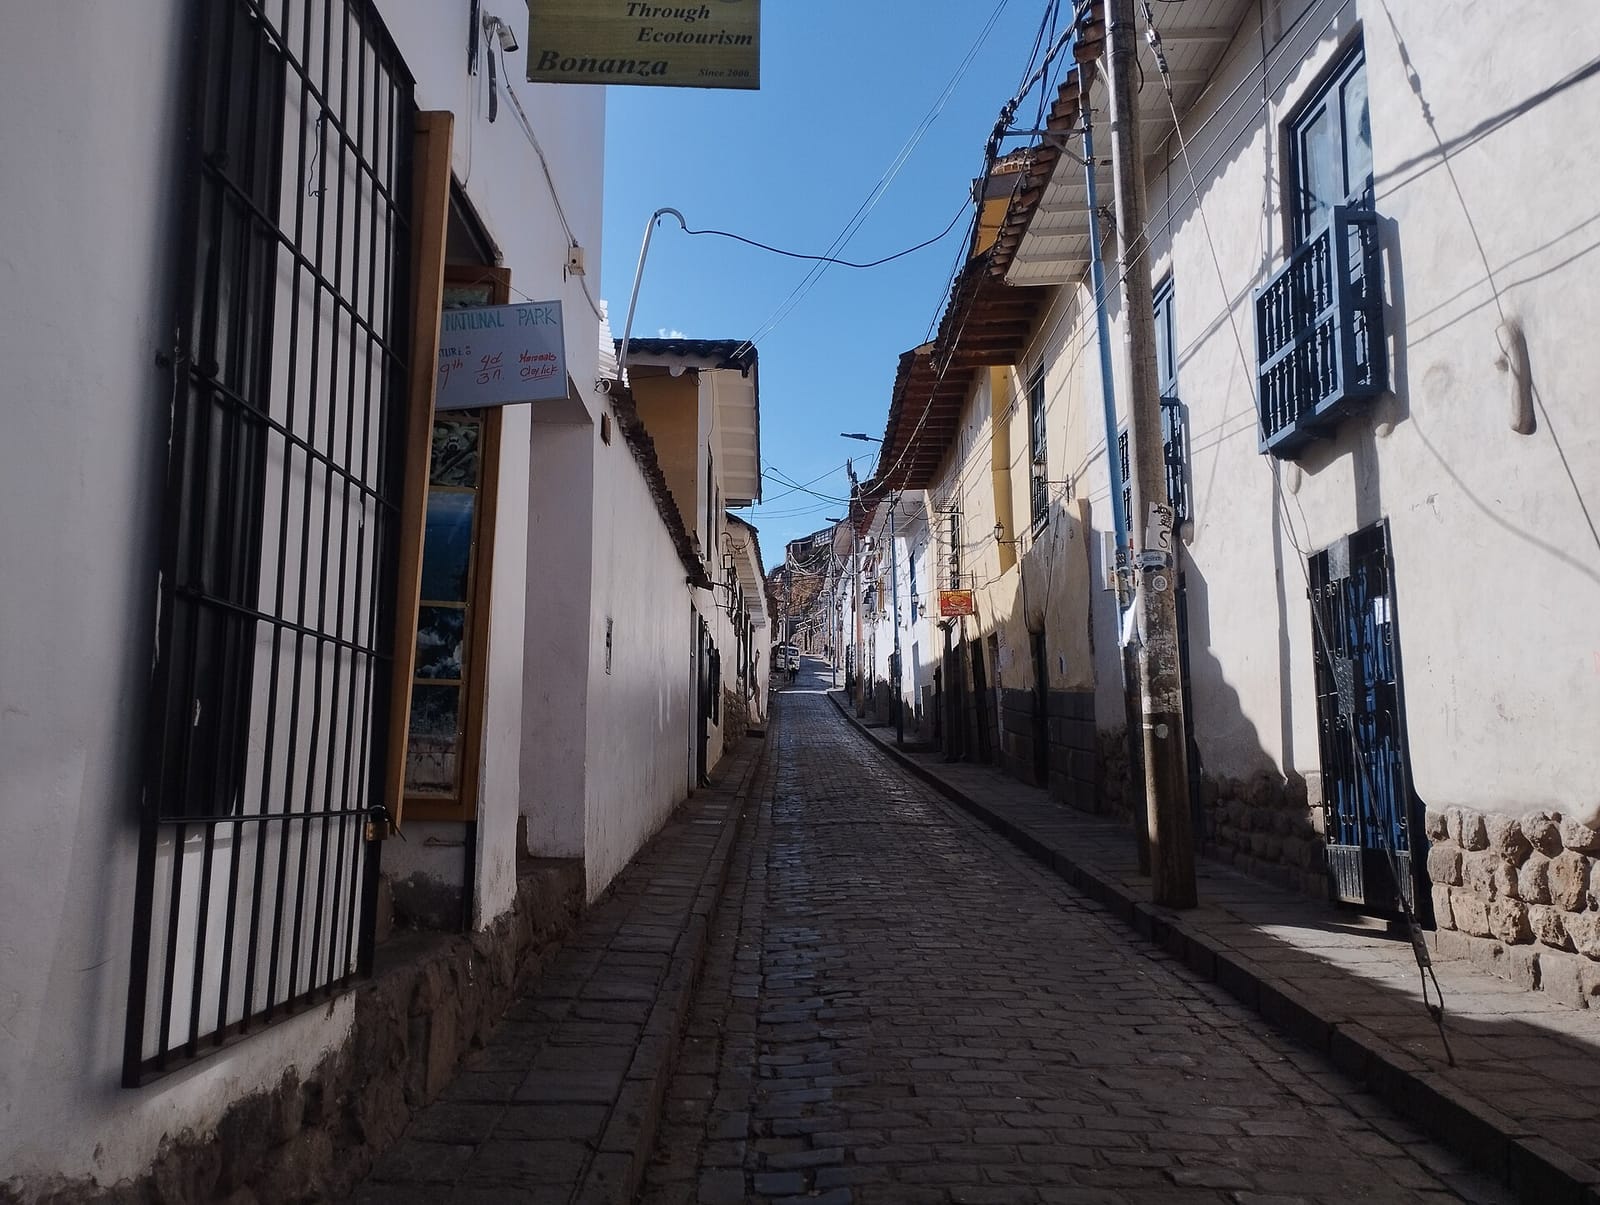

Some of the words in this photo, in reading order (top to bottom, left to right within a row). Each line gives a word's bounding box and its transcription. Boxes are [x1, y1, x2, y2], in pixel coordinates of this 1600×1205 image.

[626, 2, 710, 23] Through
[637, 27, 753, 46] Ecotourism
[536, 50, 669, 77] Bonanza
[698, 67, 725, 78] Since
[516, 306, 557, 327] PARK
